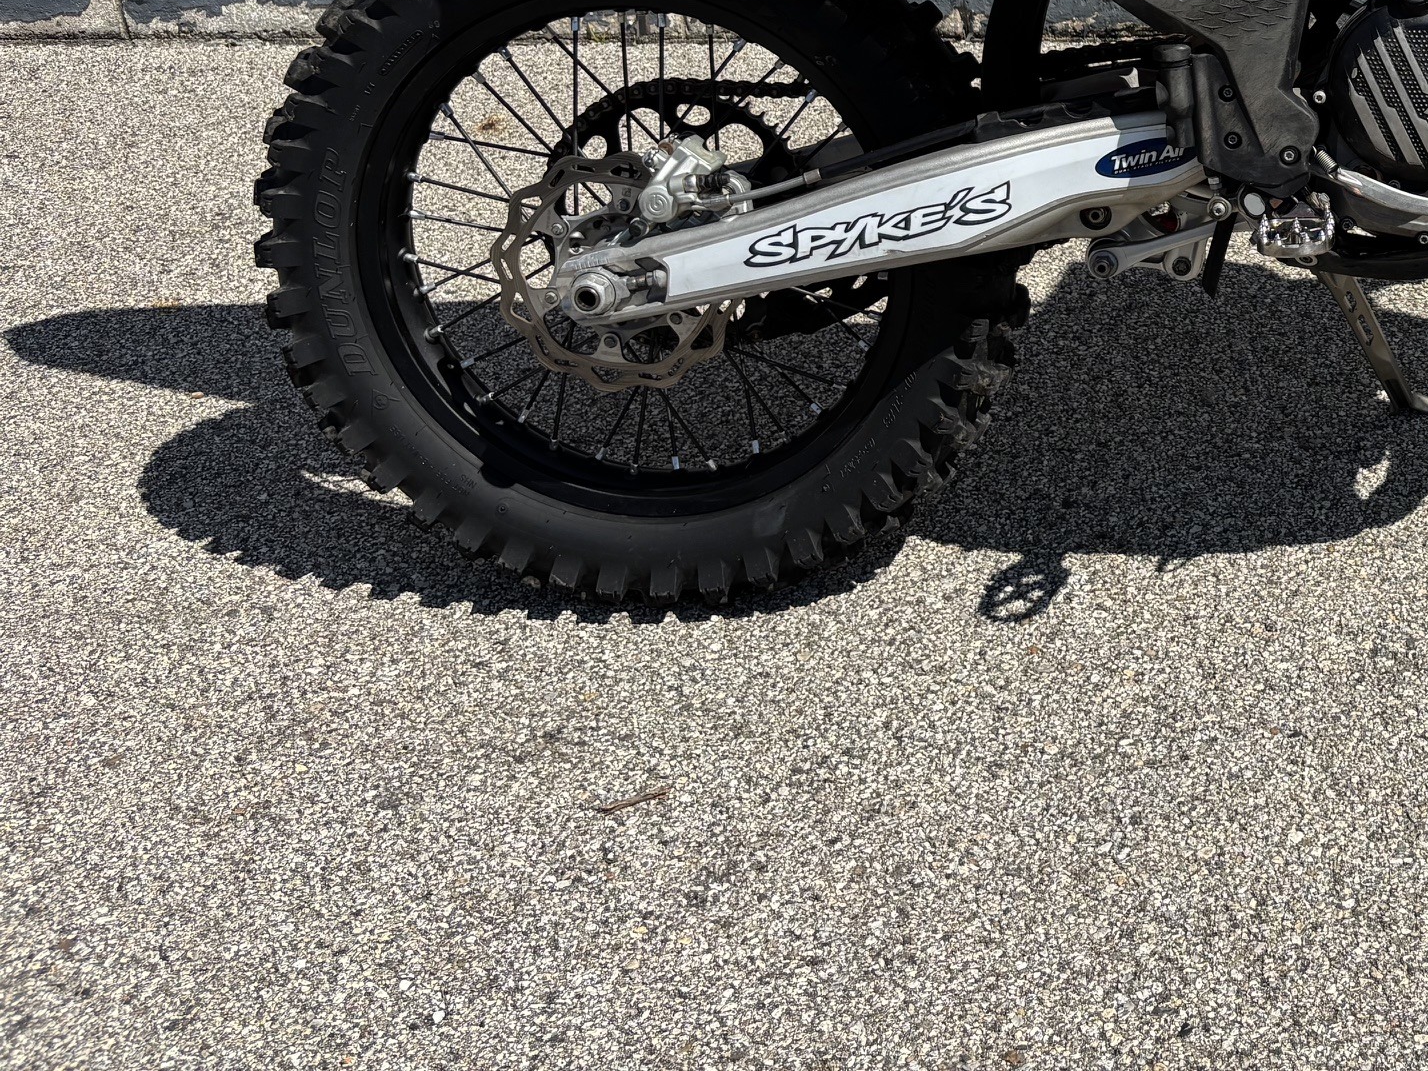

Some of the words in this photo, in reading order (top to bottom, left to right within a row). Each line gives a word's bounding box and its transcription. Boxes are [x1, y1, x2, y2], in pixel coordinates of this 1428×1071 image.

[1111, 149, 1158, 171] Twin
[312, 145, 379, 377] DUNLOP
[743, 181, 1014, 268] SPYKE'S
